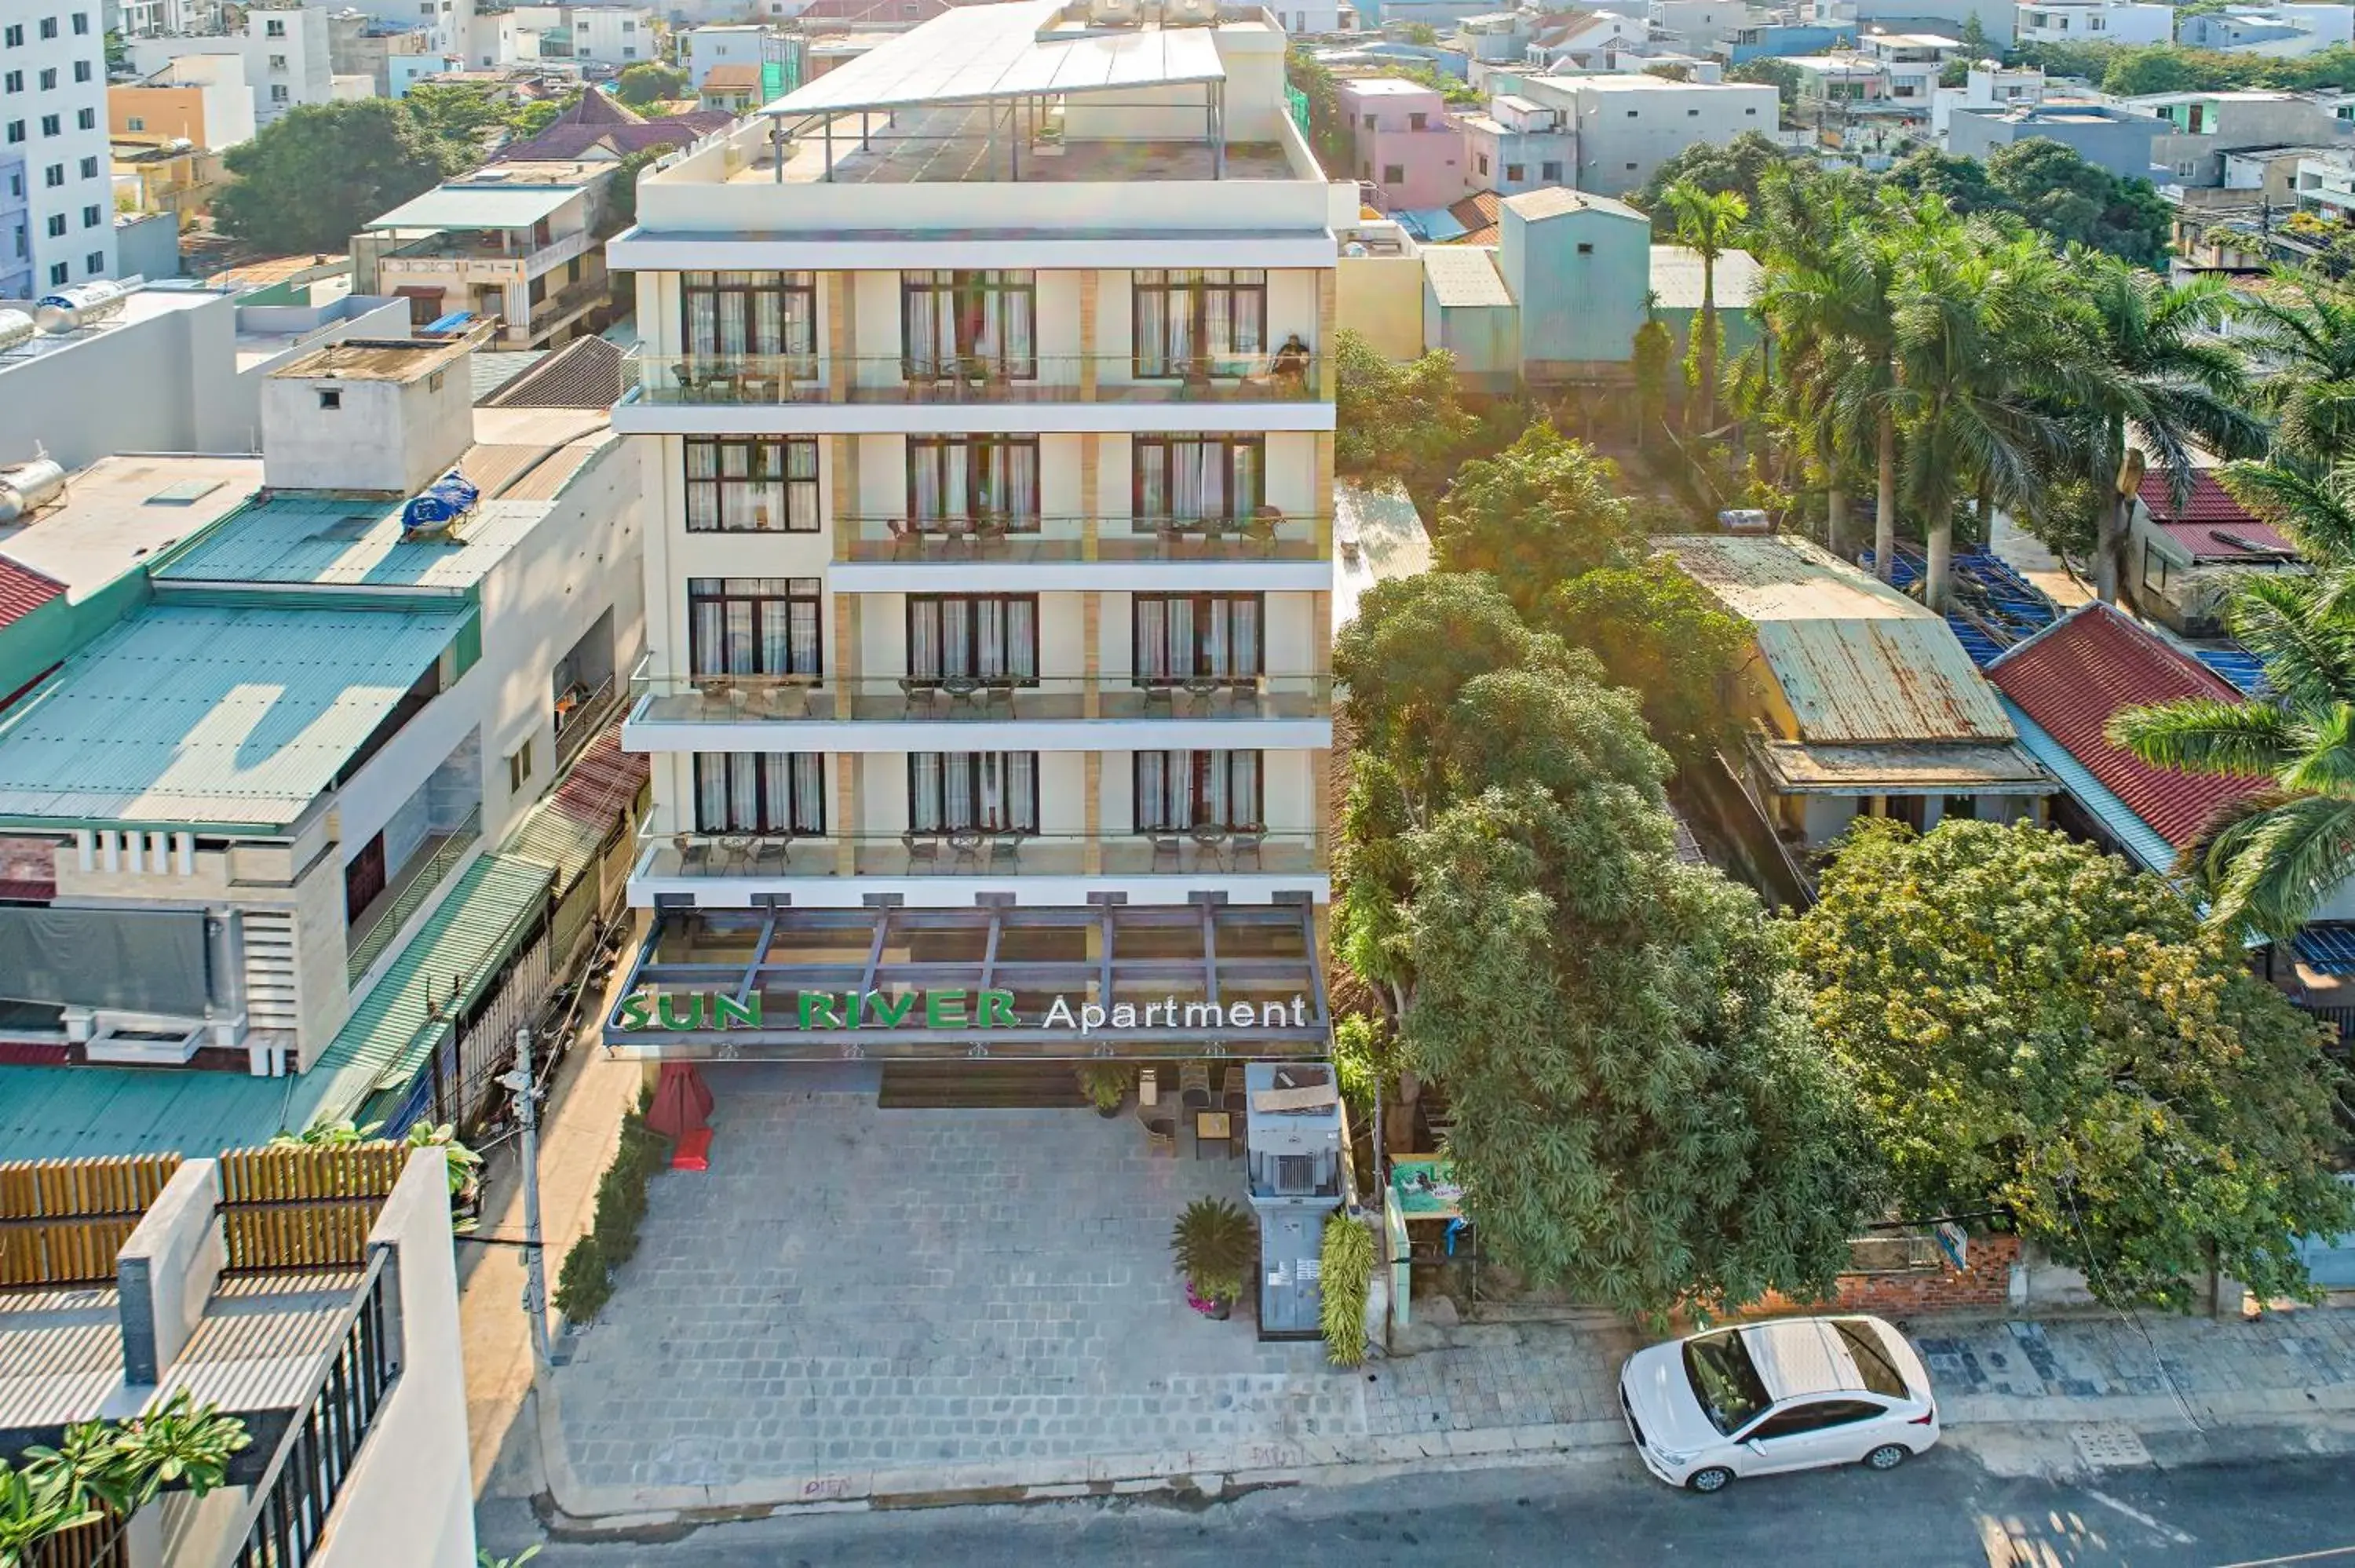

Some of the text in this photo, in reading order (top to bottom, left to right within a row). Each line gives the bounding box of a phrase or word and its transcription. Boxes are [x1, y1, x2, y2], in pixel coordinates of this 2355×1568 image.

[620, 989, 1306, 1035] SUN RIVER Apartment
